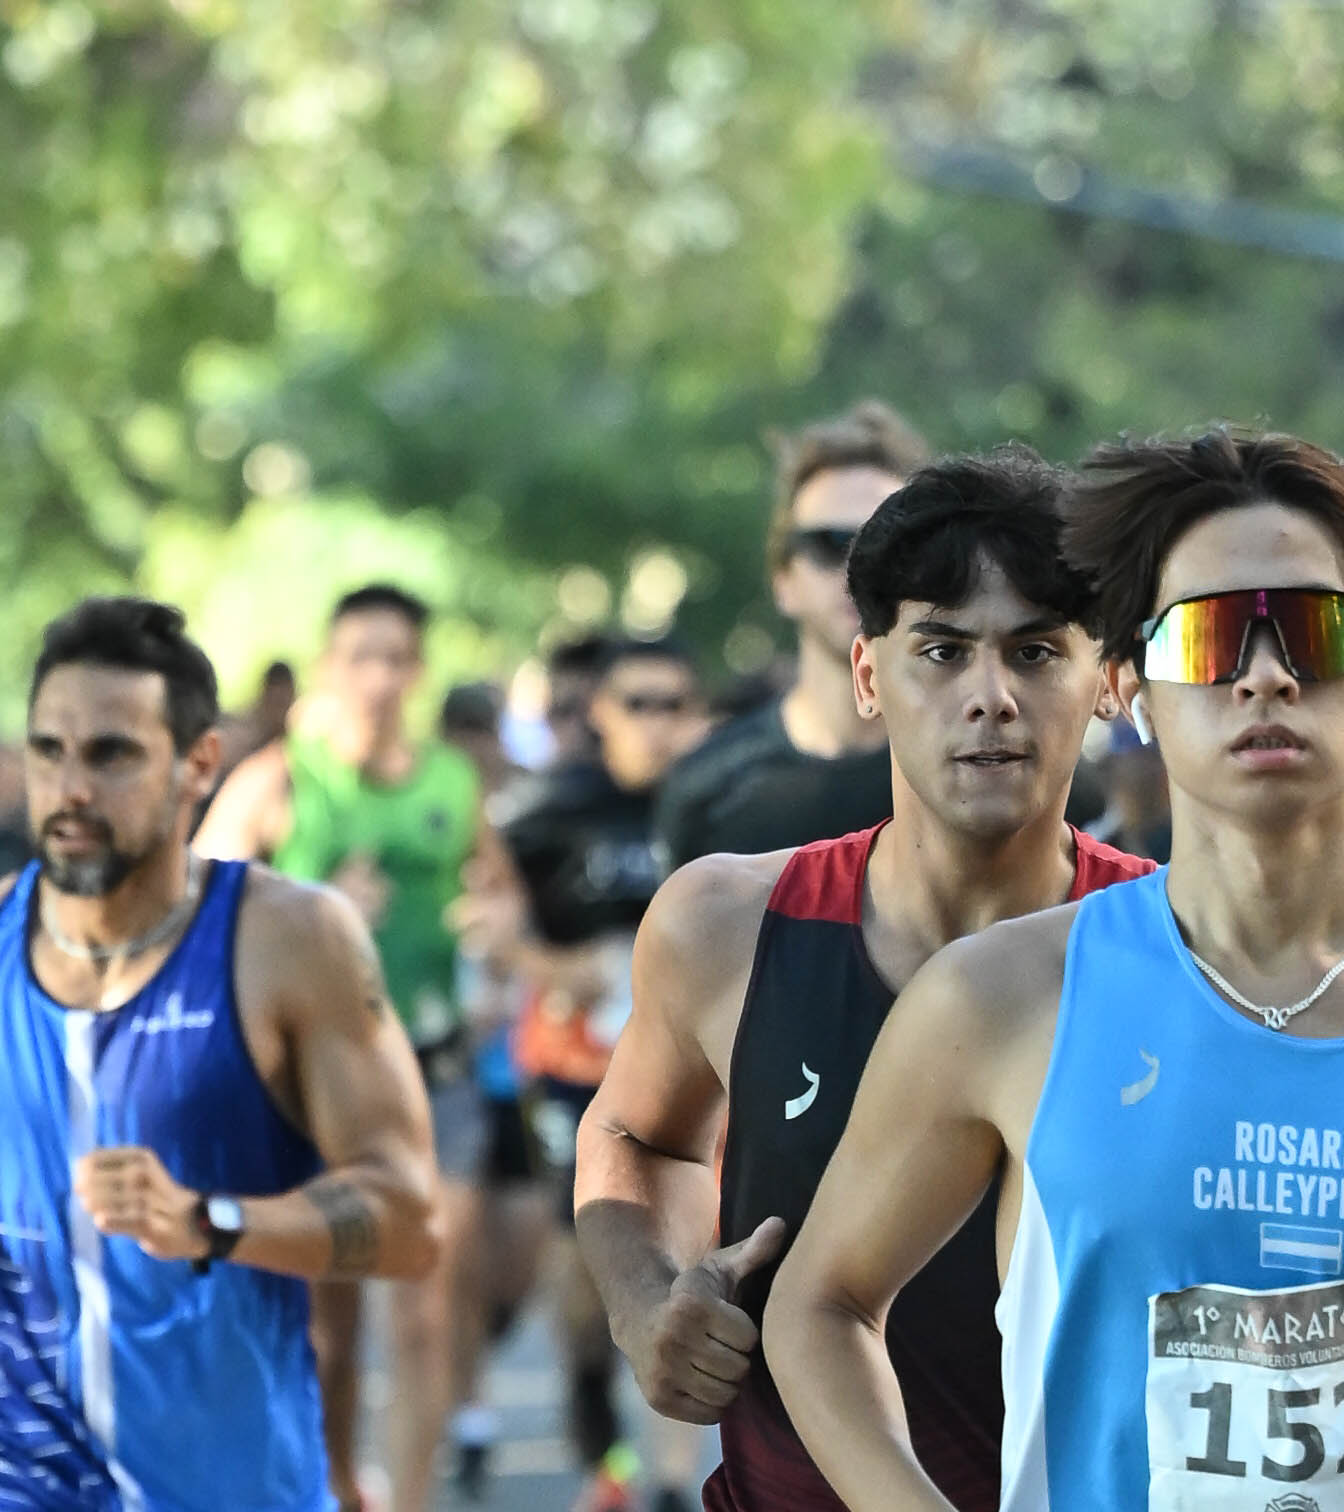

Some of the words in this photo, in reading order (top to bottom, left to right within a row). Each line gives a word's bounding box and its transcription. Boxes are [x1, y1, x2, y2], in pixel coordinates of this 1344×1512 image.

[1193, 1166, 1344, 1219] CALLEYP
[1234, 1304, 1344, 1346] MARAT
[1186, 1381, 1344, 1483] 15
